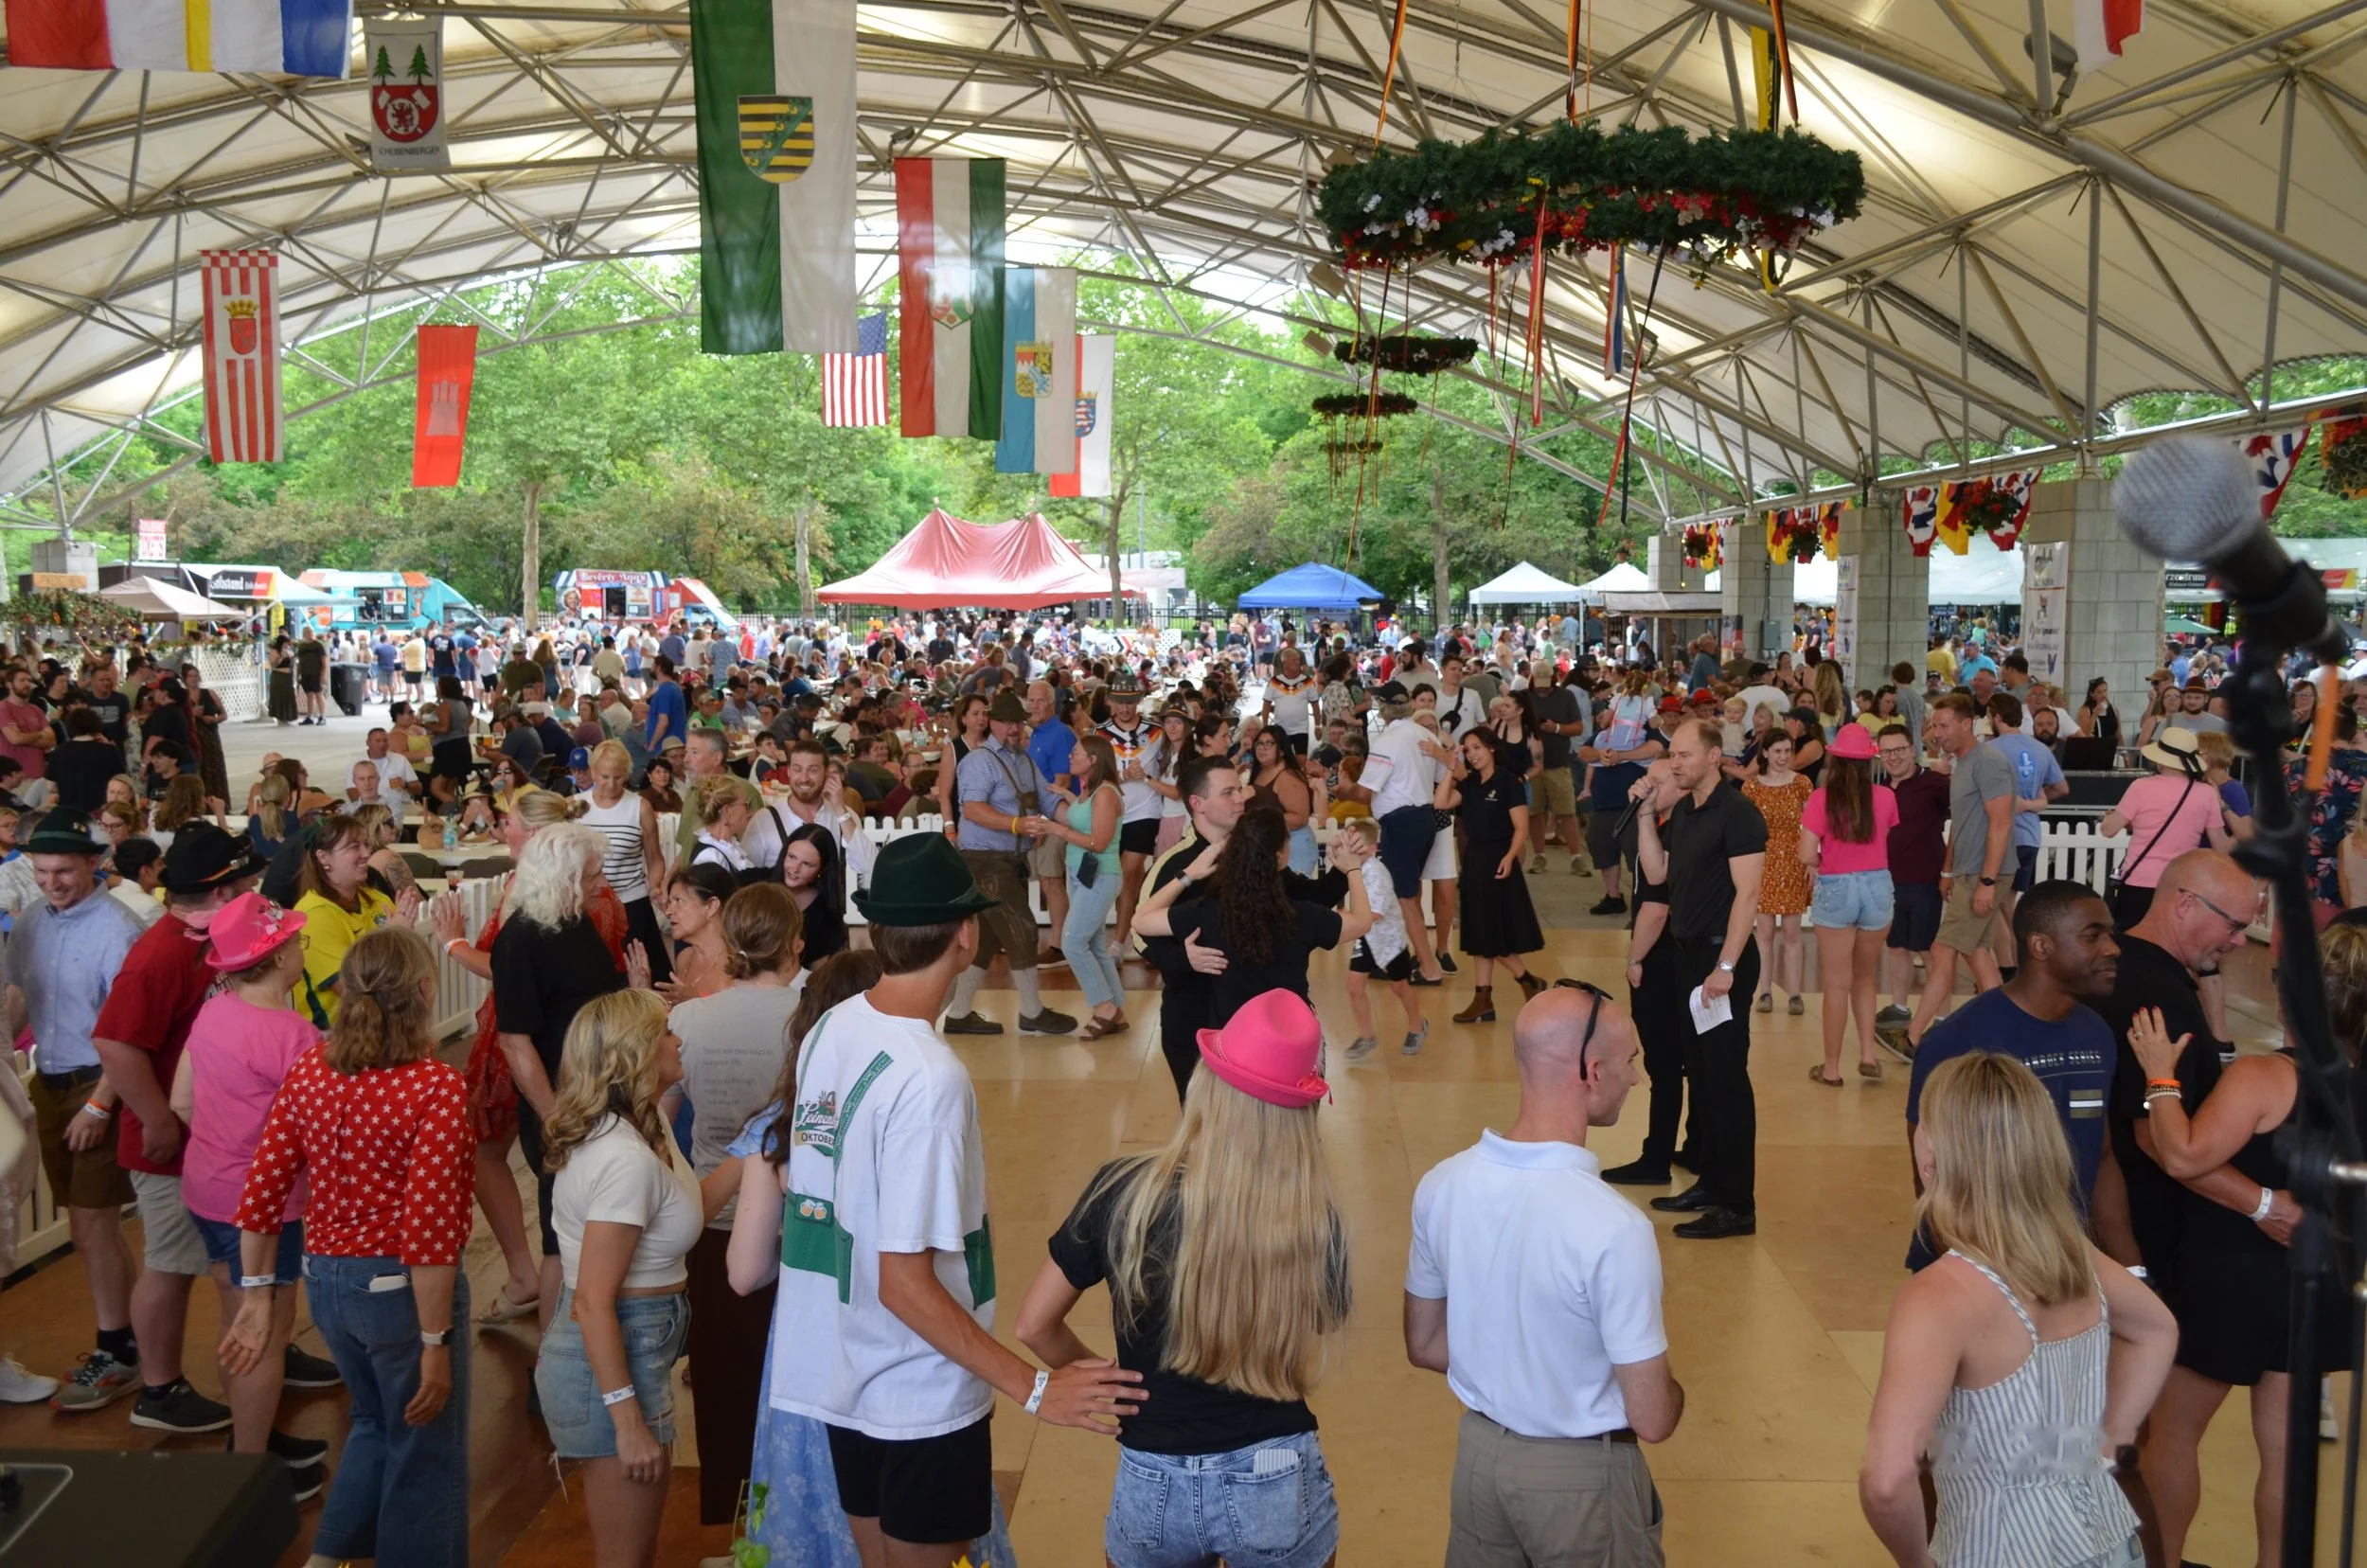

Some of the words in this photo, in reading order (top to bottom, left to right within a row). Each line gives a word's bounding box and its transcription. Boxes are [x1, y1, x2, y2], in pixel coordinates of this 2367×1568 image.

[2165, 573, 2206, 581] rzentrum
[2019, 1052, 2065, 1069] AMROCK
[2068, 1050, 2101, 1065] SERIES
[800, 1131, 834, 1146] OKTOBE
